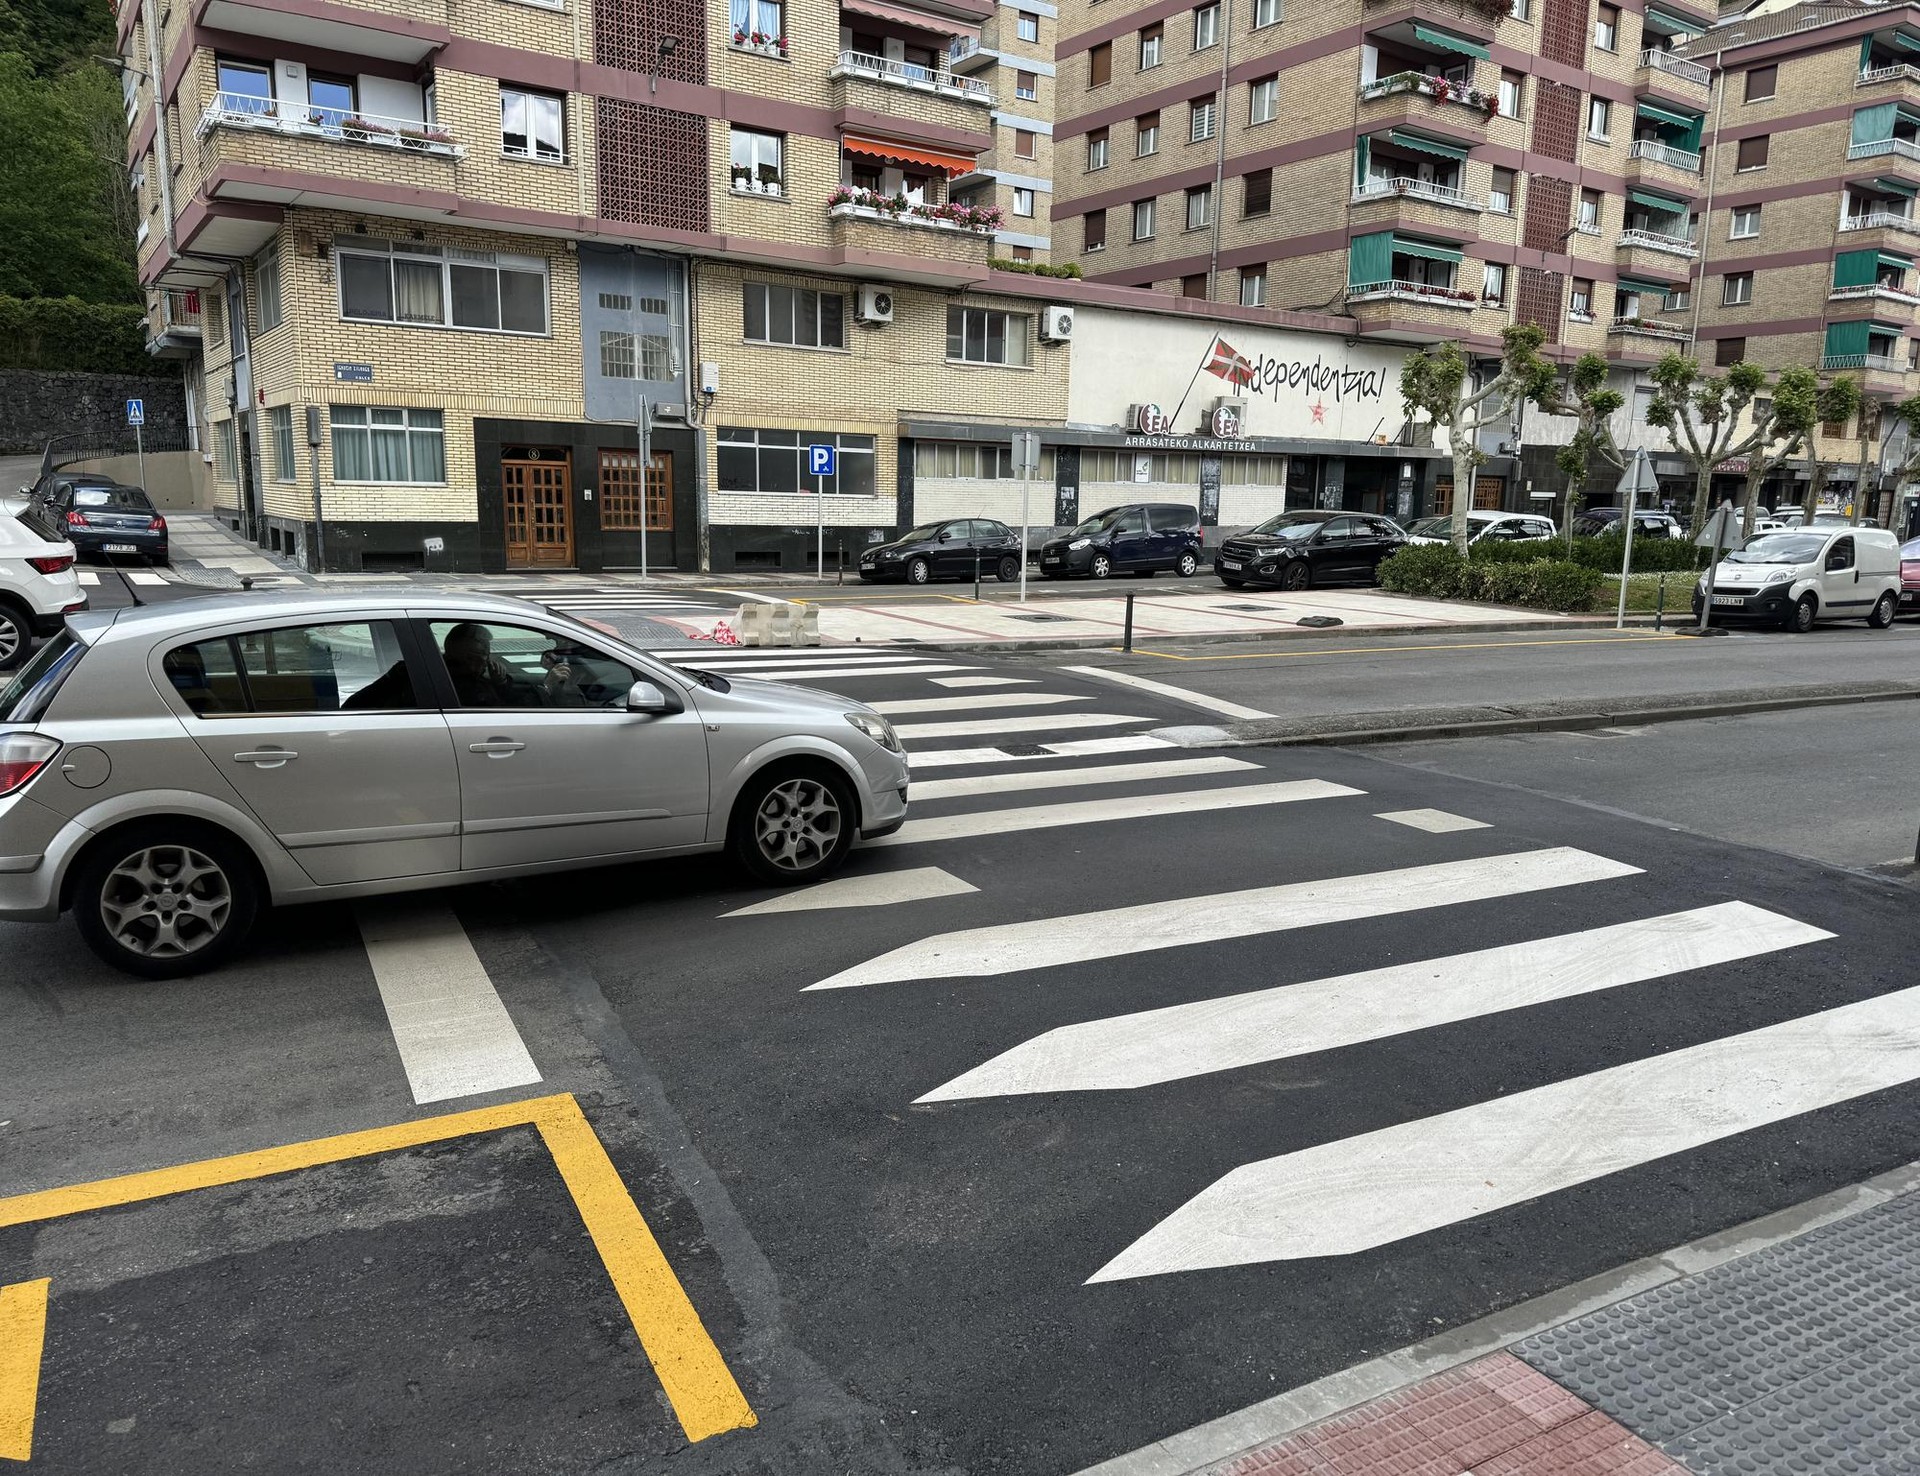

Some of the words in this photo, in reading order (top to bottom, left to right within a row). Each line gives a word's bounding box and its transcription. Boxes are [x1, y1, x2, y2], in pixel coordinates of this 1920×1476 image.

[1125, 436, 1189, 448] ARRASATEKO
[1192, 439, 1256, 451] ALKARTETXEA
[813, 448, 829, 471] P
